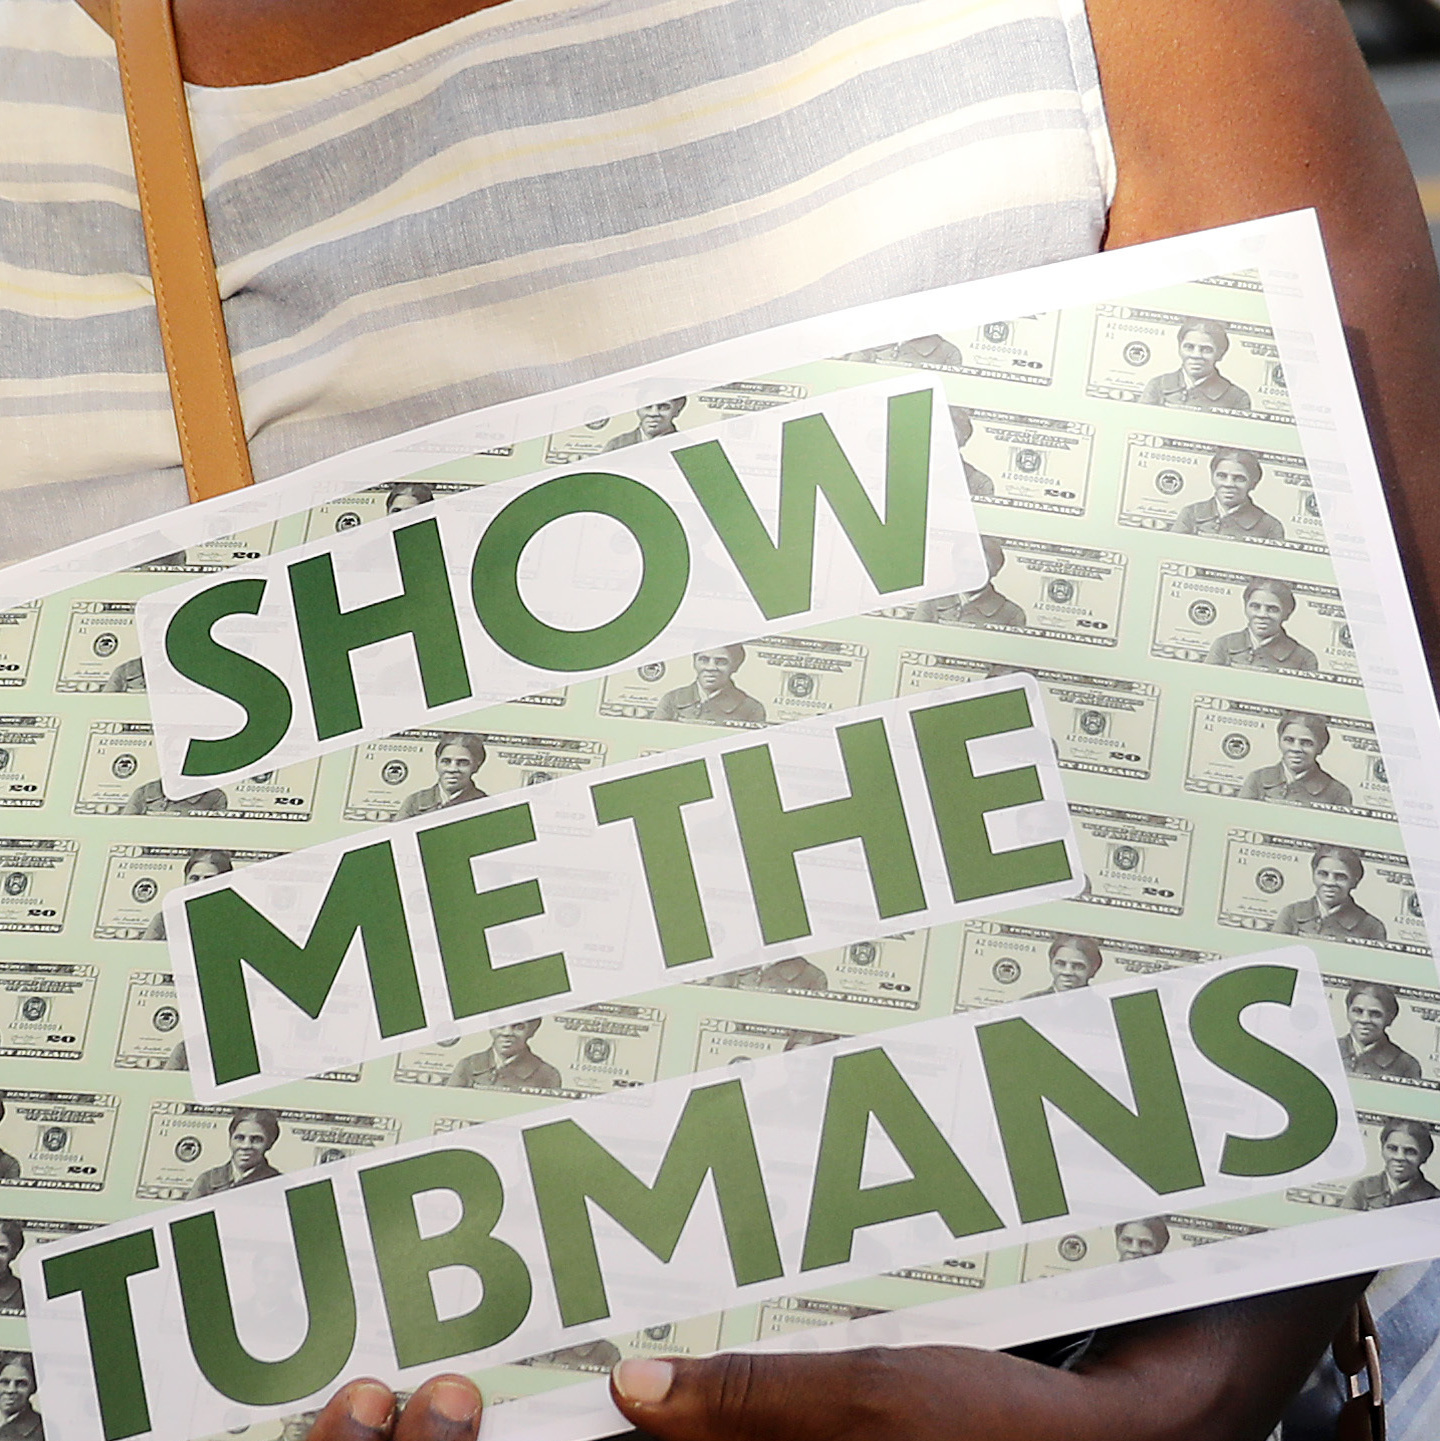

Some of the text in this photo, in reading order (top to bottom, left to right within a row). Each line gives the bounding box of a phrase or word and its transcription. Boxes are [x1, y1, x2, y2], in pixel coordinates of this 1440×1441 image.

[1010, 357, 1043, 370] 20
[1042, 487, 1076, 500] 20
[231, 551, 261, 560] 20
[164, 387, 937, 779] SHOW
[1075, 618, 1108, 631] 20
[1107, 750, 1141, 763] 20
[8, 783, 37, 792] 20
[273, 796, 304, 806] 20
[185, 686, 1073, 1087] ME THE
[1140, 886, 1175, 899] 20
[26, 908, 56, 917] 20
[877, 981, 911, 993] 20
[45, 1034, 75, 1043] 20
[66, 1165, 97, 1175] 20
[41, 963, 1340, 1441] TUBMANS
